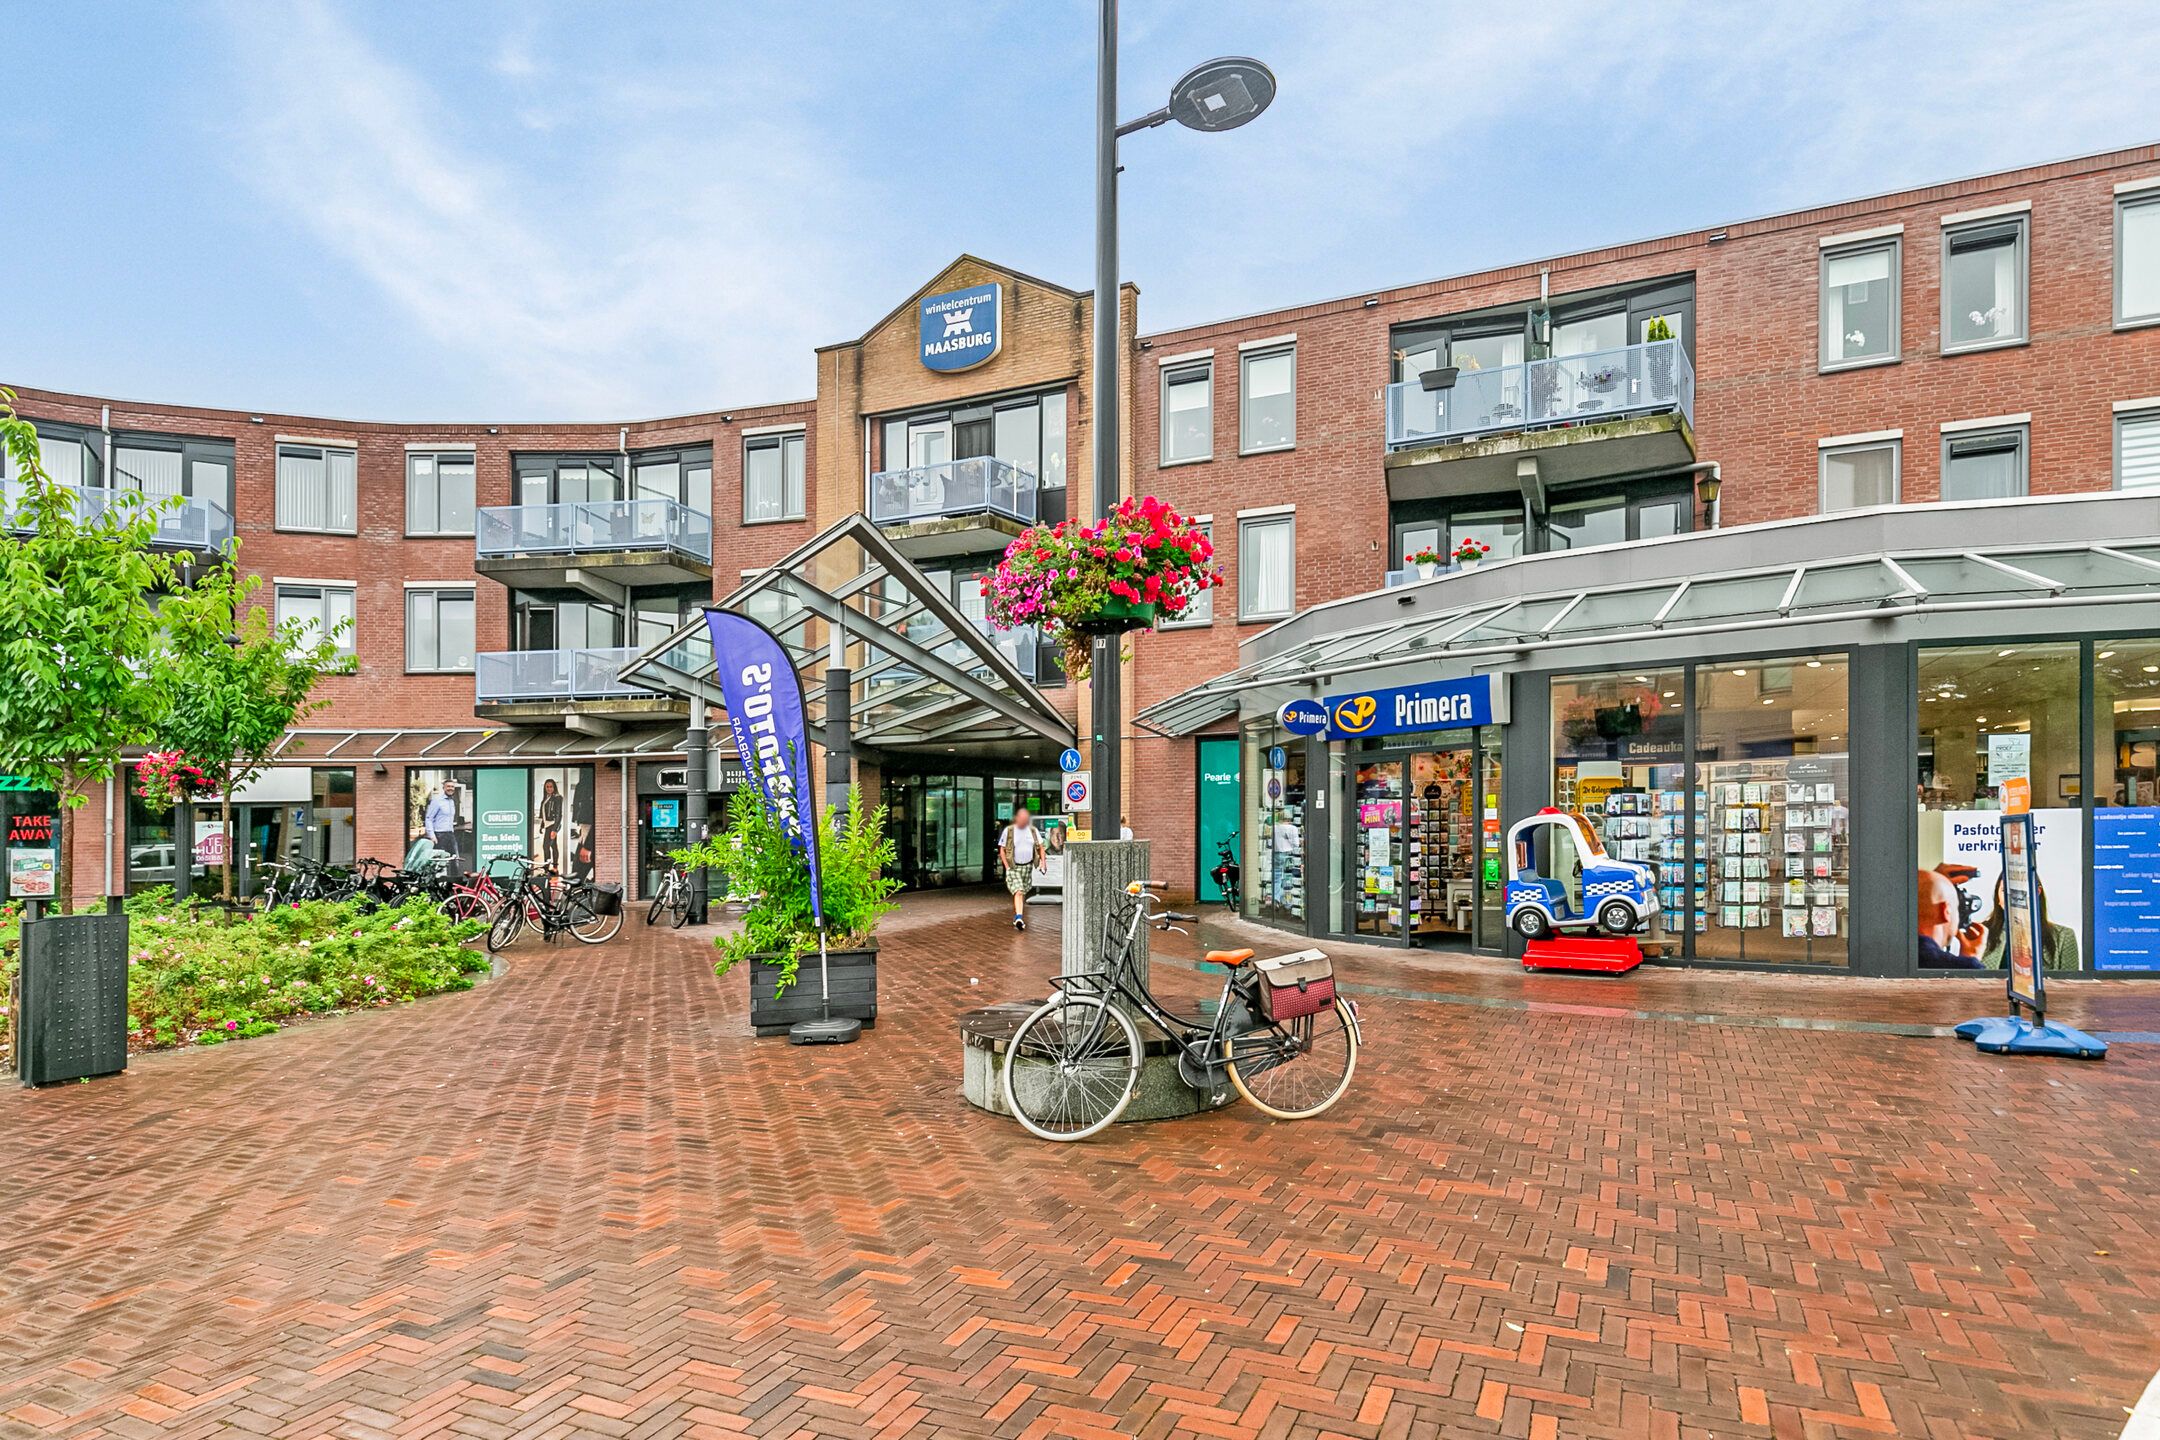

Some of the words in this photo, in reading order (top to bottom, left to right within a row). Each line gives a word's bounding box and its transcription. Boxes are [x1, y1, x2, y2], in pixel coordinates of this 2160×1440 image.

[925, 293, 992, 315] winkelcentrum
[925, 331, 992, 357] MAASBURG
[1395, 692, 1472, 727] Primera
[1299, 711, 1327, 724] Primera
[1628, 741, 1715, 754] Cadeaukaten
[1204, 772, 1232, 782] Pearle
[12, 815, 52, 827] TAKE
[9, 829, 54, 840] AWAY
[481, 833, 498, 842] Een
[481, 842, 523, 852] momentje
